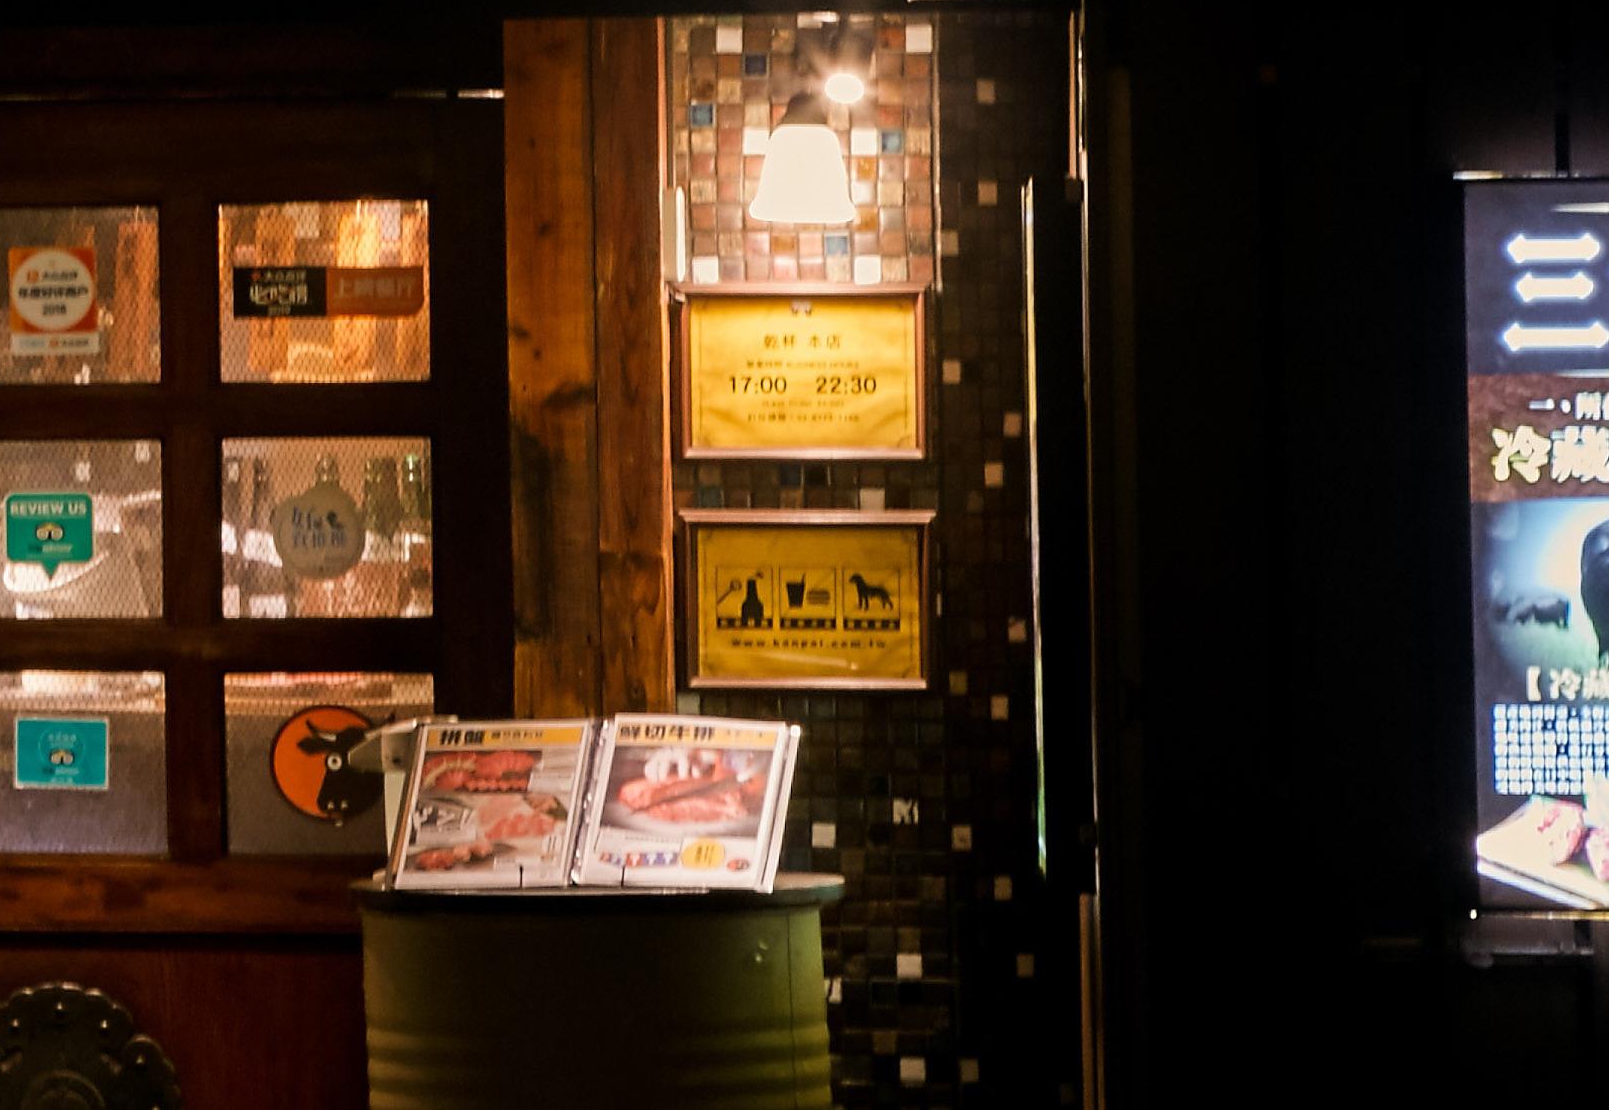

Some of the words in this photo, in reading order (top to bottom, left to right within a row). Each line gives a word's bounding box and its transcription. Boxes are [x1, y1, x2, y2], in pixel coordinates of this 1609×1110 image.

[729, 375, 787, 394] 17:00
[815, 375, 877, 395] 22:30
[10, 501, 64, 517] REVIEW
